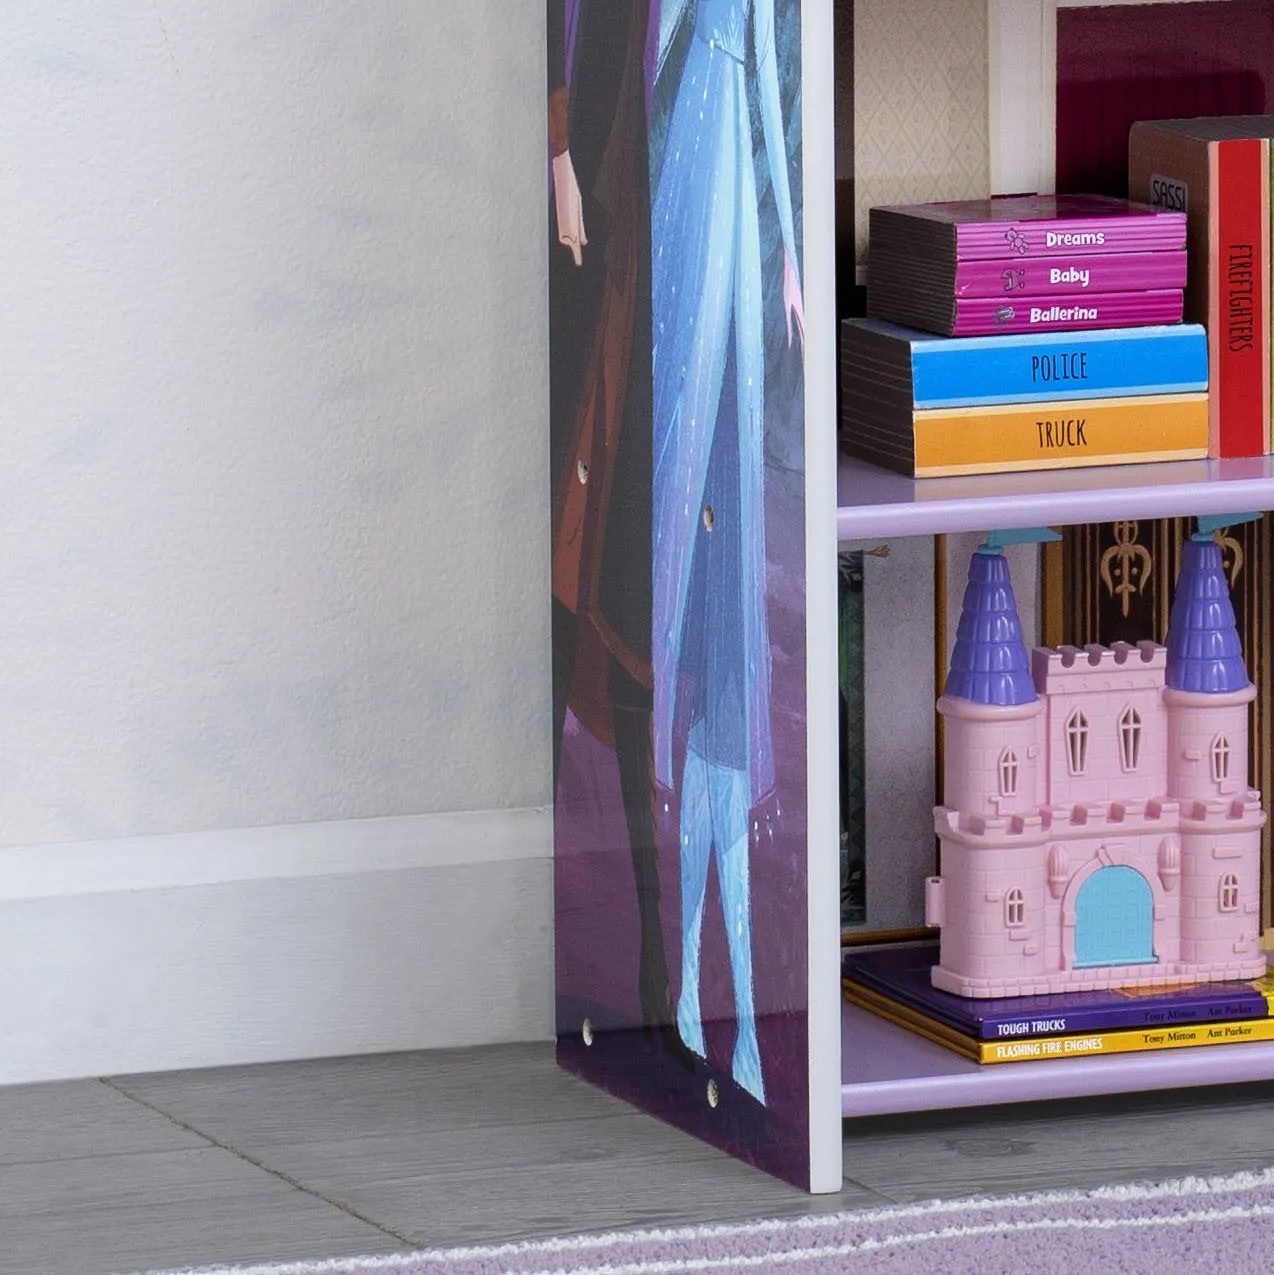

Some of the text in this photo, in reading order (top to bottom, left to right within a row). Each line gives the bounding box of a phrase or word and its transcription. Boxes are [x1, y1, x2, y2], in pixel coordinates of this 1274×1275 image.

[1046, 232, 1105, 247] Dreams
[1050, 267, 1089, 287] Baby
[1228, 244, 1253, 352] FIREFIGHTERS
[1030, 307, 1098, 323] Ballerina
[1032, 352, 1088, 383] POLICE
[1036, 419, 1087, 448] TRUCK
[997, 1023, 1029, 1035] TOUGH
[1032, 1019, 1066, 1032] TRUCKS
[997, 1027, 1253, 1058] FLASHING FIRE ENGINES Tony Mitton Ant Parker
